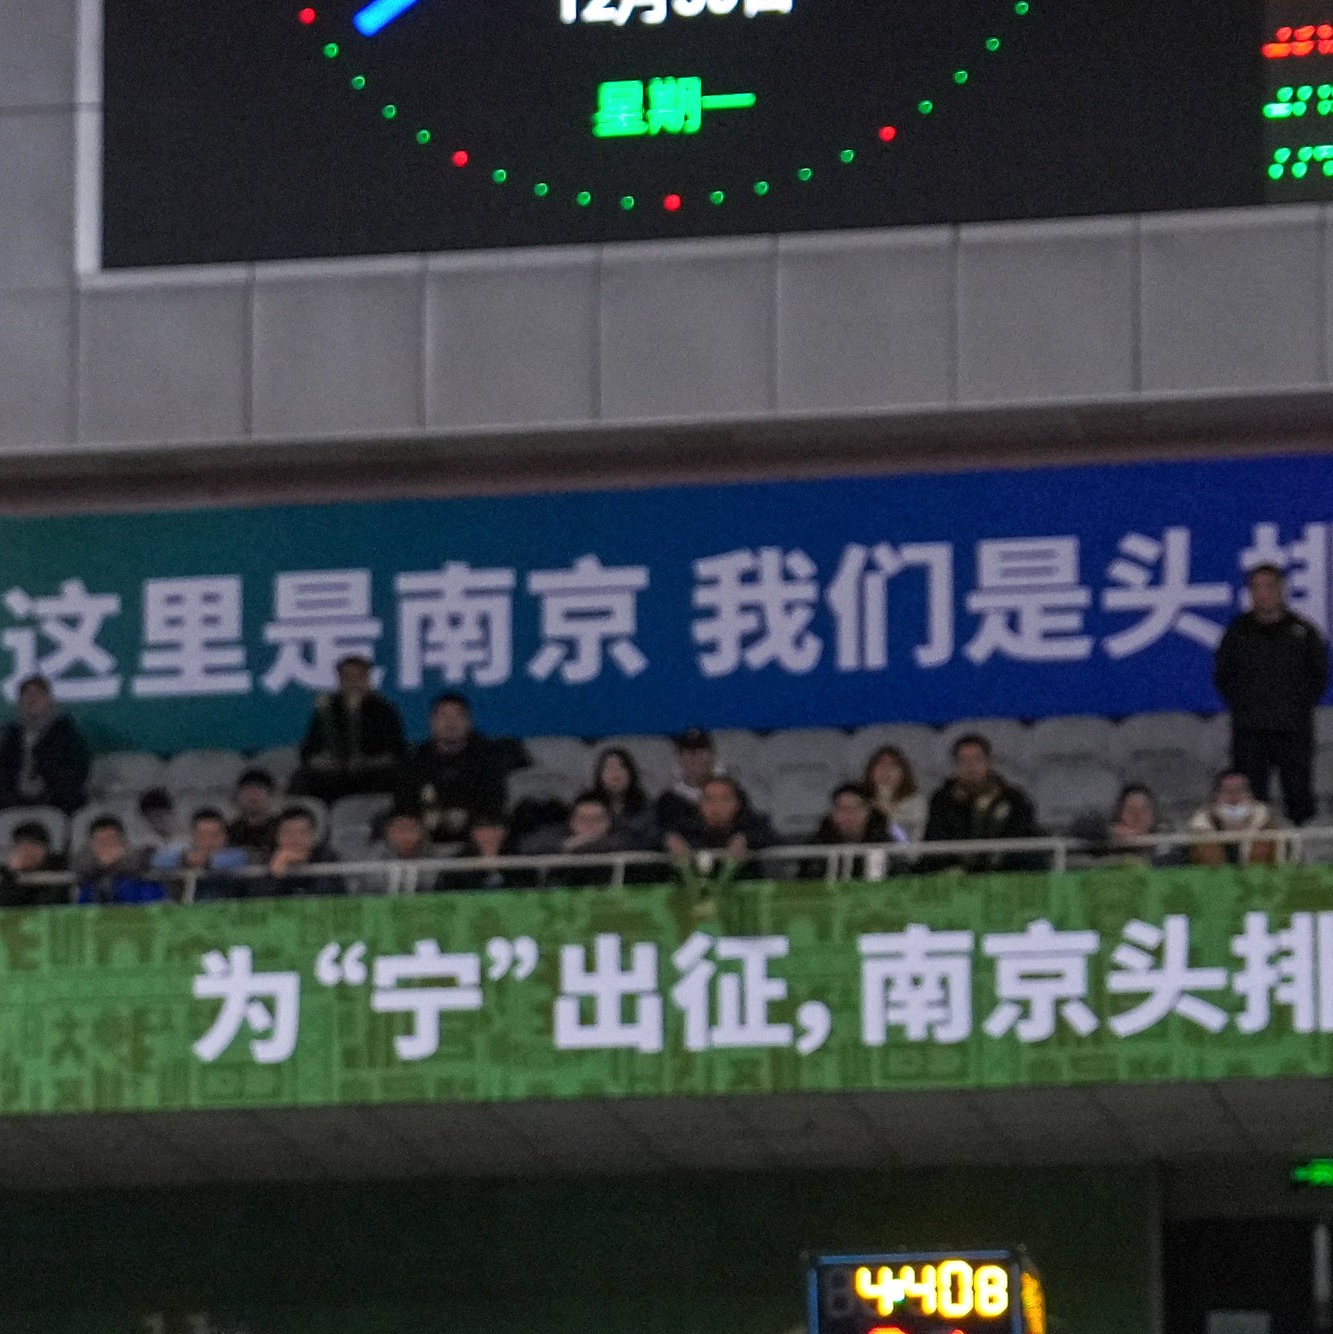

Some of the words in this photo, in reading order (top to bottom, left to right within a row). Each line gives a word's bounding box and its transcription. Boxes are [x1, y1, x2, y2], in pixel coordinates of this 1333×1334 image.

[1, 554, 650, 701] 这里是南京
